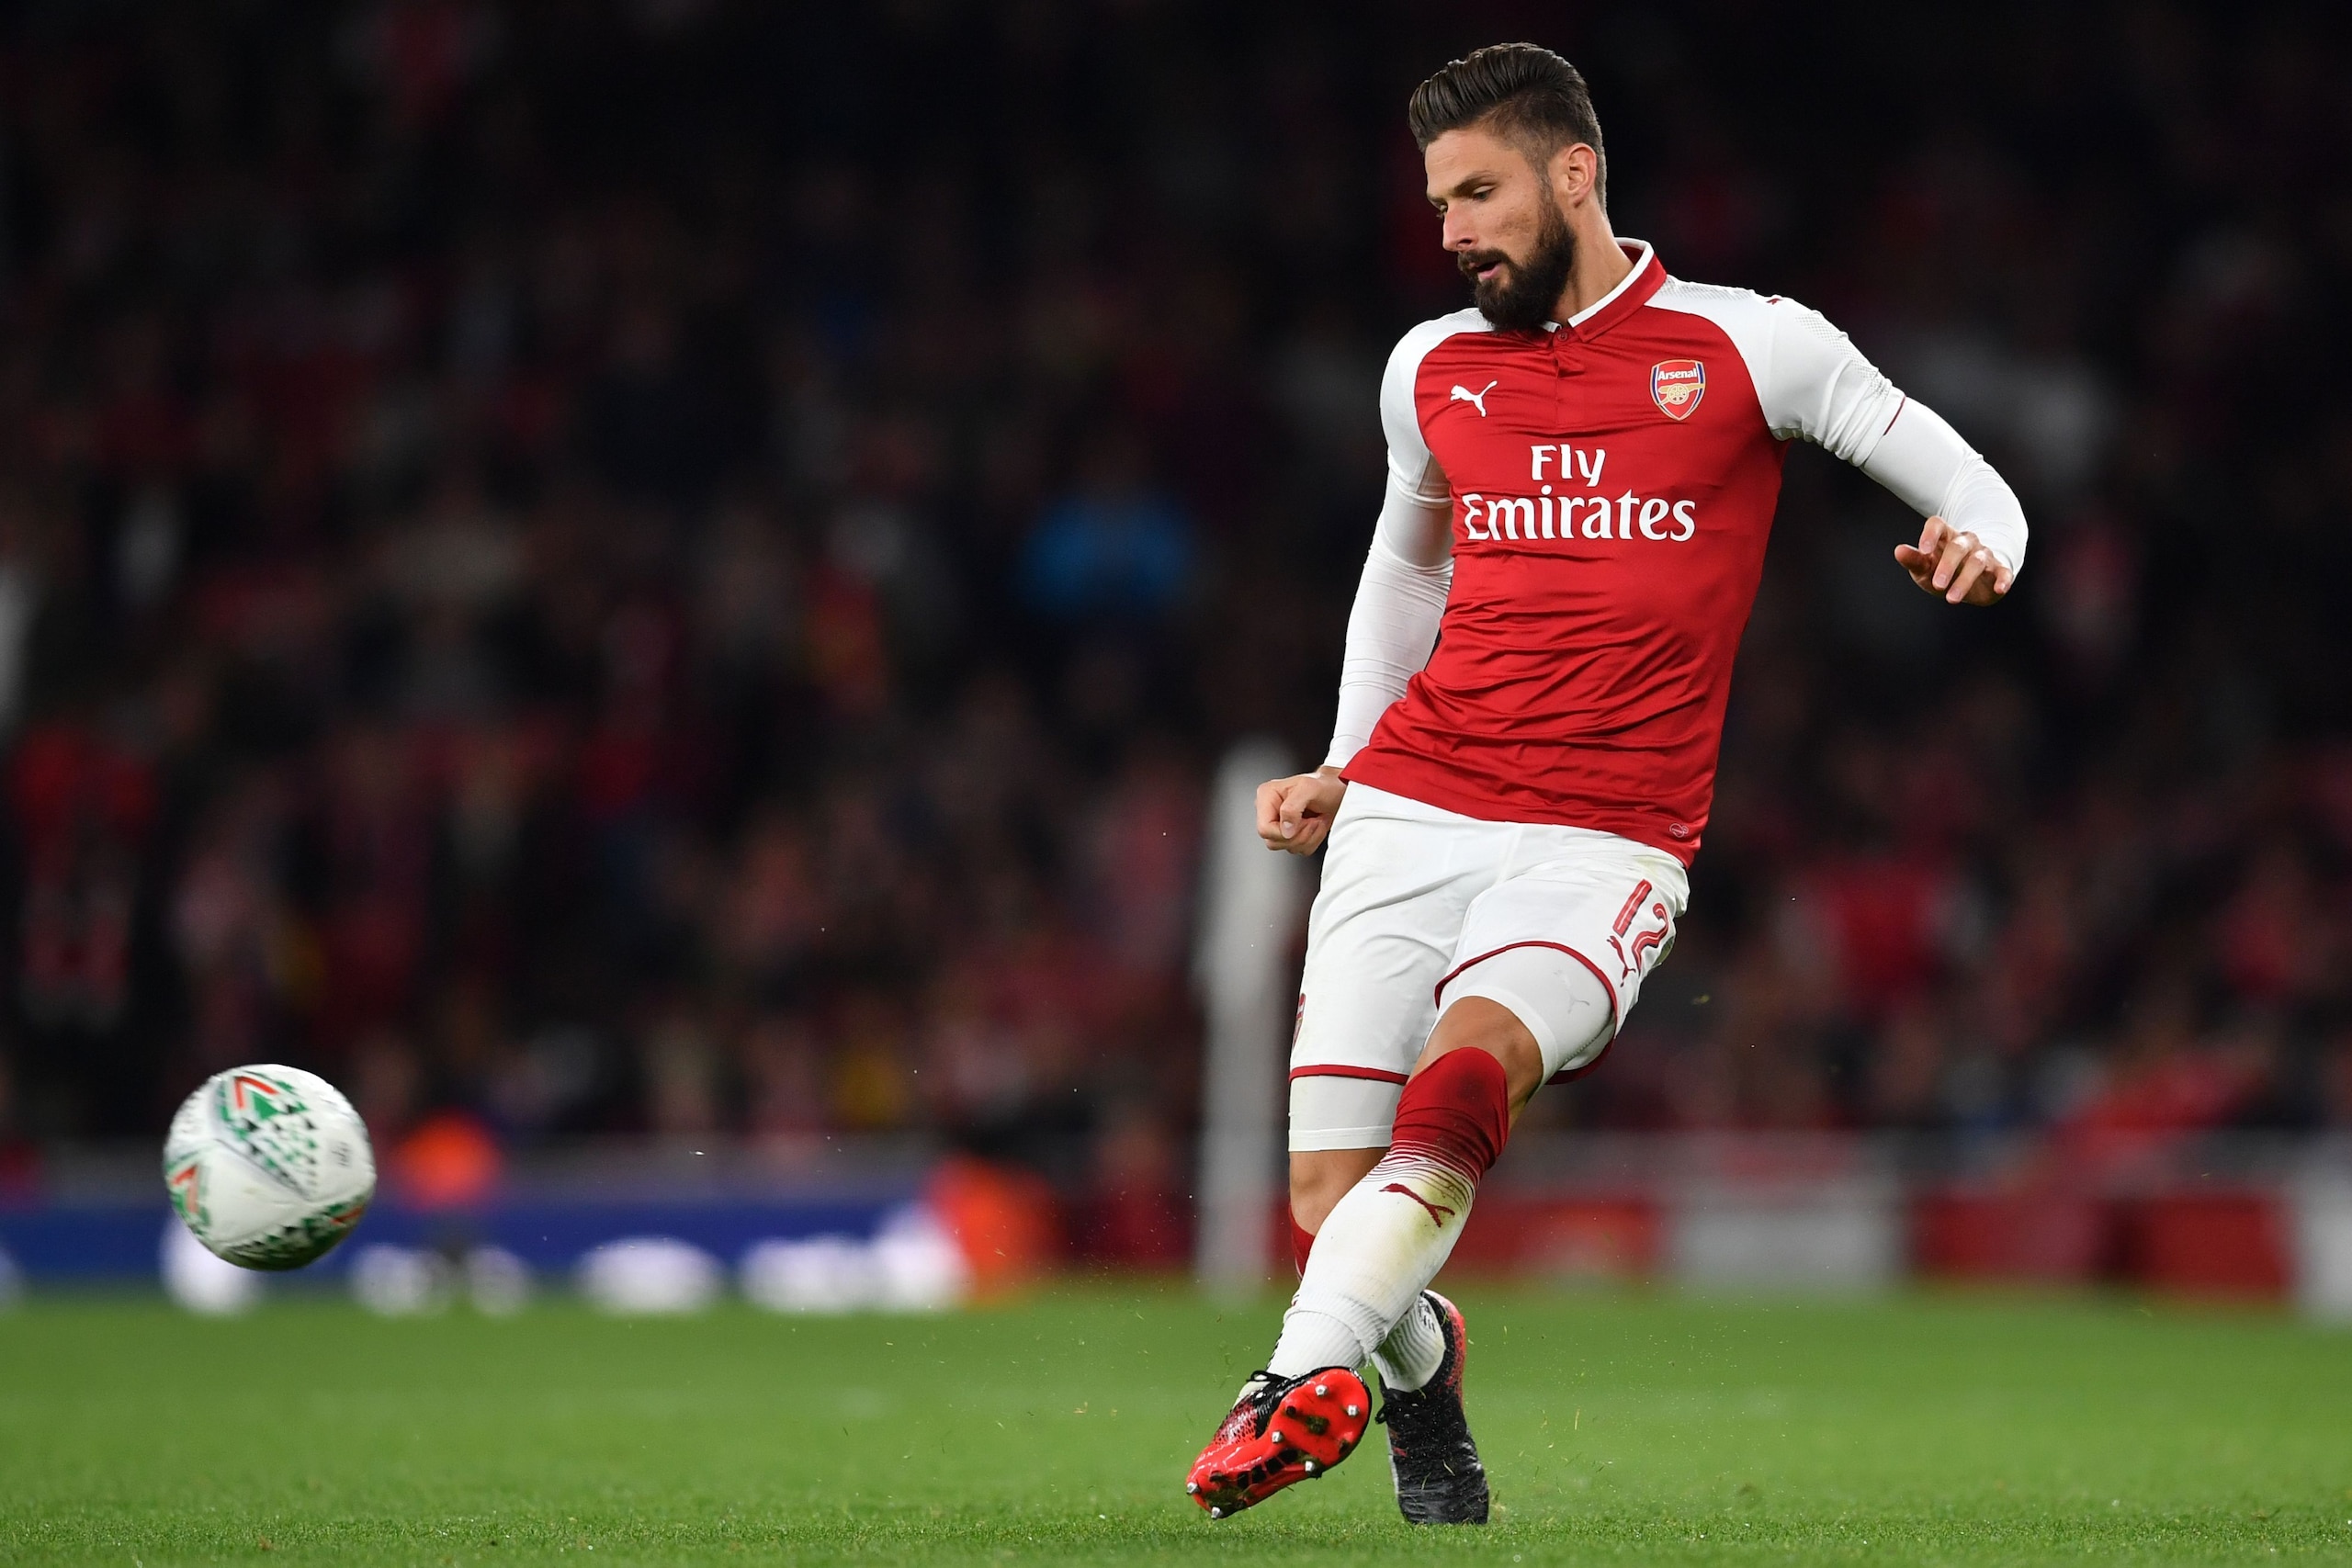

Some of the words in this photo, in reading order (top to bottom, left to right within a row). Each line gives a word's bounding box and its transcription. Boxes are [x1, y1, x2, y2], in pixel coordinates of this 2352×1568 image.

[1657, 367, 1698, 381] Arsenal
[1530, 444, 1606, 487] Fly
[1463, 485, 1696, 541] Emirates
[1612, 878, 1669, 976] 12
